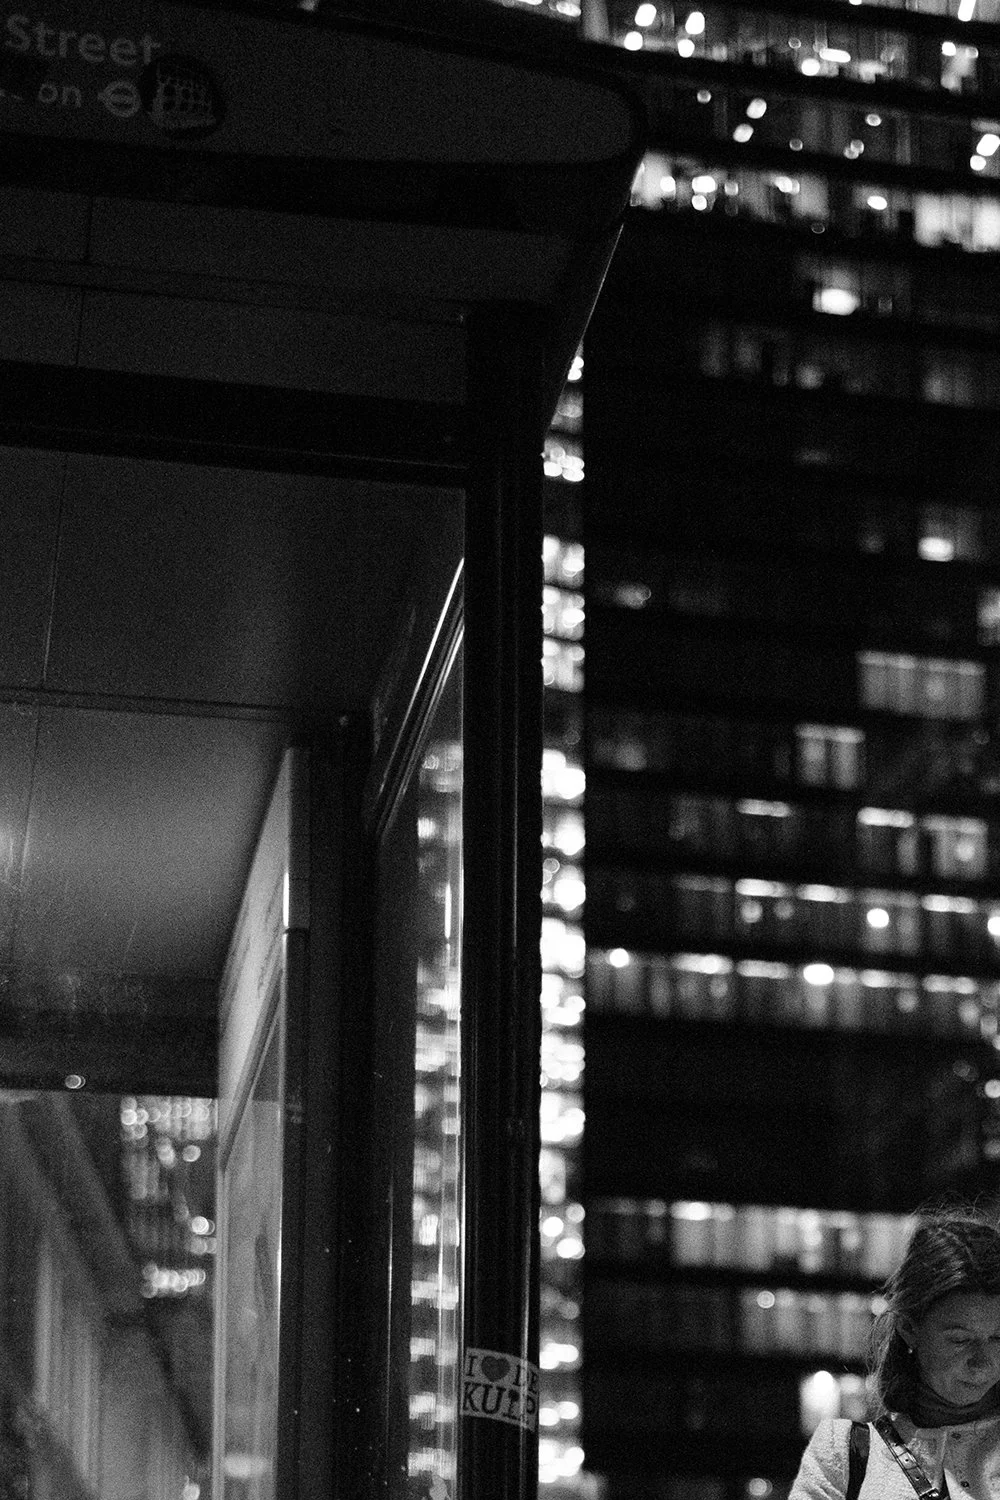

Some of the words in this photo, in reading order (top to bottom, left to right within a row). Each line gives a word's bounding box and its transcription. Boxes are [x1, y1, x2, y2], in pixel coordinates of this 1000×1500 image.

[4, 14, 161, 66] Street
[38, 83, 82, 107] on
[466, 1355, 478, 1376] I
